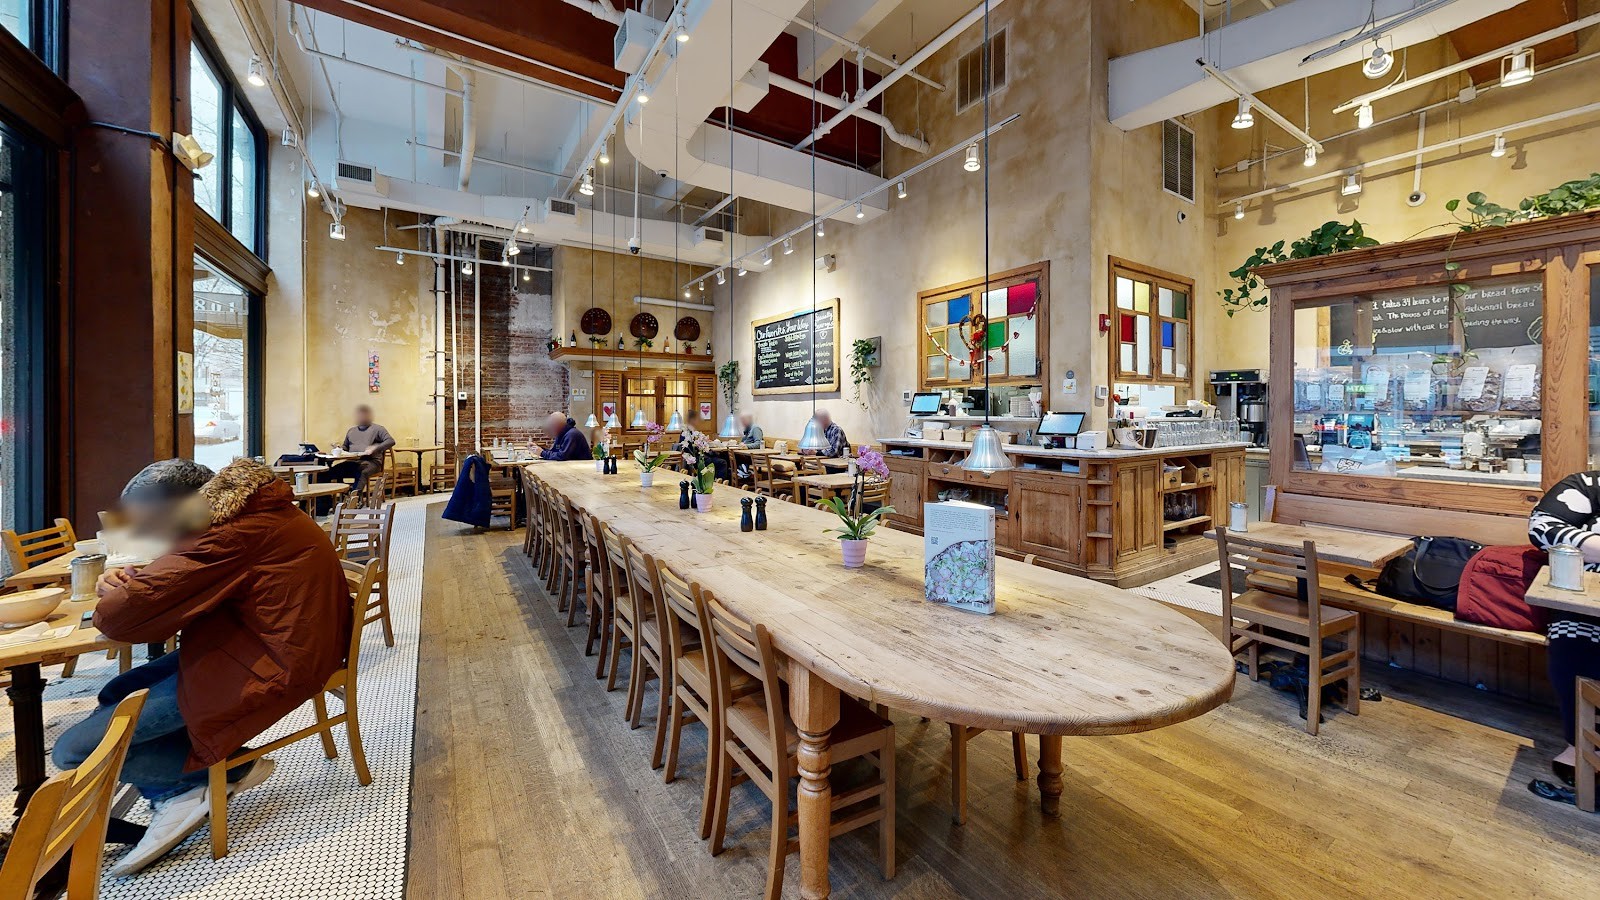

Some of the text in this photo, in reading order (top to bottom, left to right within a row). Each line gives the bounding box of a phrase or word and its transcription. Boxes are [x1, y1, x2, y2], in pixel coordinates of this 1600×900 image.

[1382, 299, 1401, 309] takes
[1412, 296, 1430, 306] hours
[1432, 295, 1441, 304] to
[1464, 292, 1478, 300] our
[1481, 288, 1506, 298] bread
[1511, 286, 1530, 295] from
[1386, 311, 1400, 320] The
[1422, 308, 1431, 316] of
[1433, 305, 1449, 316] craft
[1506, 299, 1535, 309] bread
[1405, 323, 1421, 332] with
[1422, 323, 1435, 331] our
